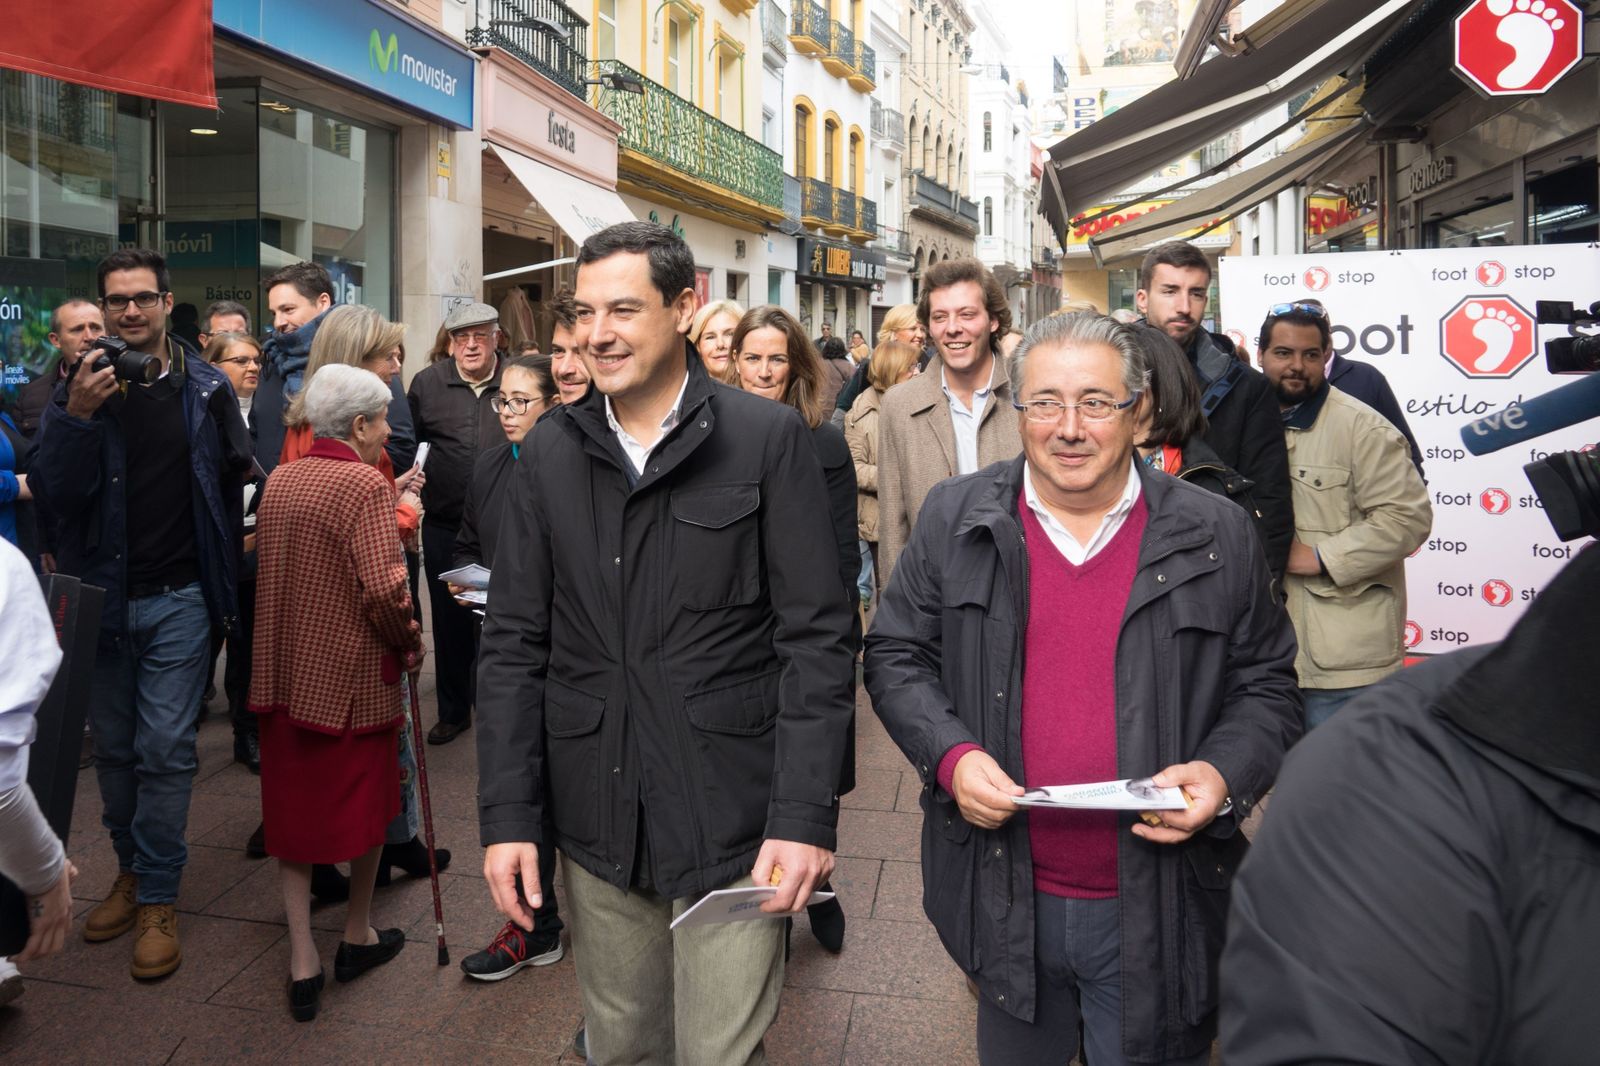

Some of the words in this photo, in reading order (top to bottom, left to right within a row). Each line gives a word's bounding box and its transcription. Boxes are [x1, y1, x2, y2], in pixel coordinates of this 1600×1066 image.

[401, 53, 458, 97] movistar
[547, 111, 576, 154] festa
[1264, 273, 1296, 286] foot
[1338, 270, 1375, 285] stop
[1432, 267, 1468, 281] foot
[1514, 265, 1556, 280] stop
[205, 286, 252, 301] Básico
[1328, 314, 1414, 356] oot
[5, 364, 24, 374] líneas
[5, 374, 30, 384] móviles
[1406, 394, 1496, 417] estilo
[1470, 406, 1528, 436] tve
[1426, 445, 1465, 462] stop
[1435, 491, 1472, 506] foot
[1519, 494, 1545, 508] sto
[1428, 537, 1467, 555] stop
[1532, 543, 1572, 559] foot
[1437, 581, 1474, 597] foot
[1430, 627, 1469, 645] stop
